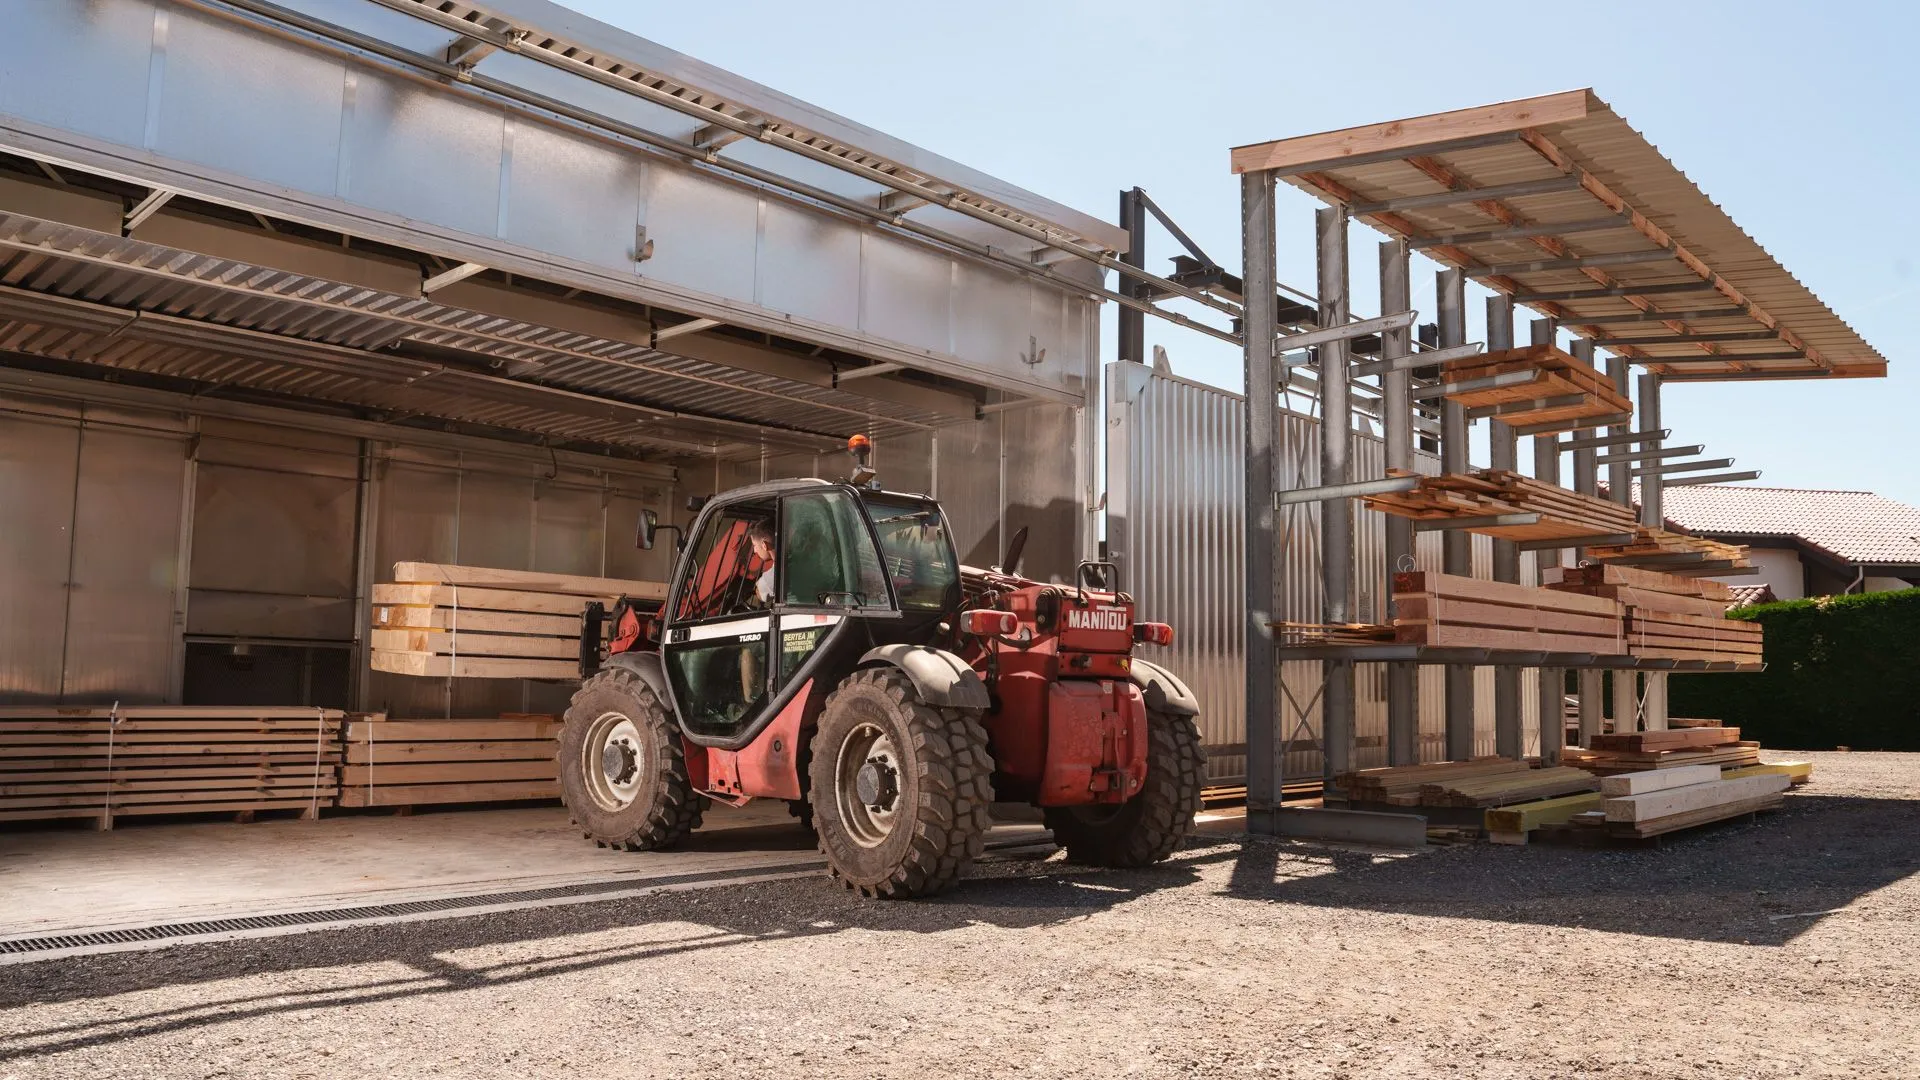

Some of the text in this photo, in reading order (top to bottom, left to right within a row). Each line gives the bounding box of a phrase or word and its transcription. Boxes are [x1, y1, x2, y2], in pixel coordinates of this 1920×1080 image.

[1068, 605, 1127, 630] MANITOU
[739, 633, 762, 642] TURBO
[783, 632, 806, 642] BERTEA
